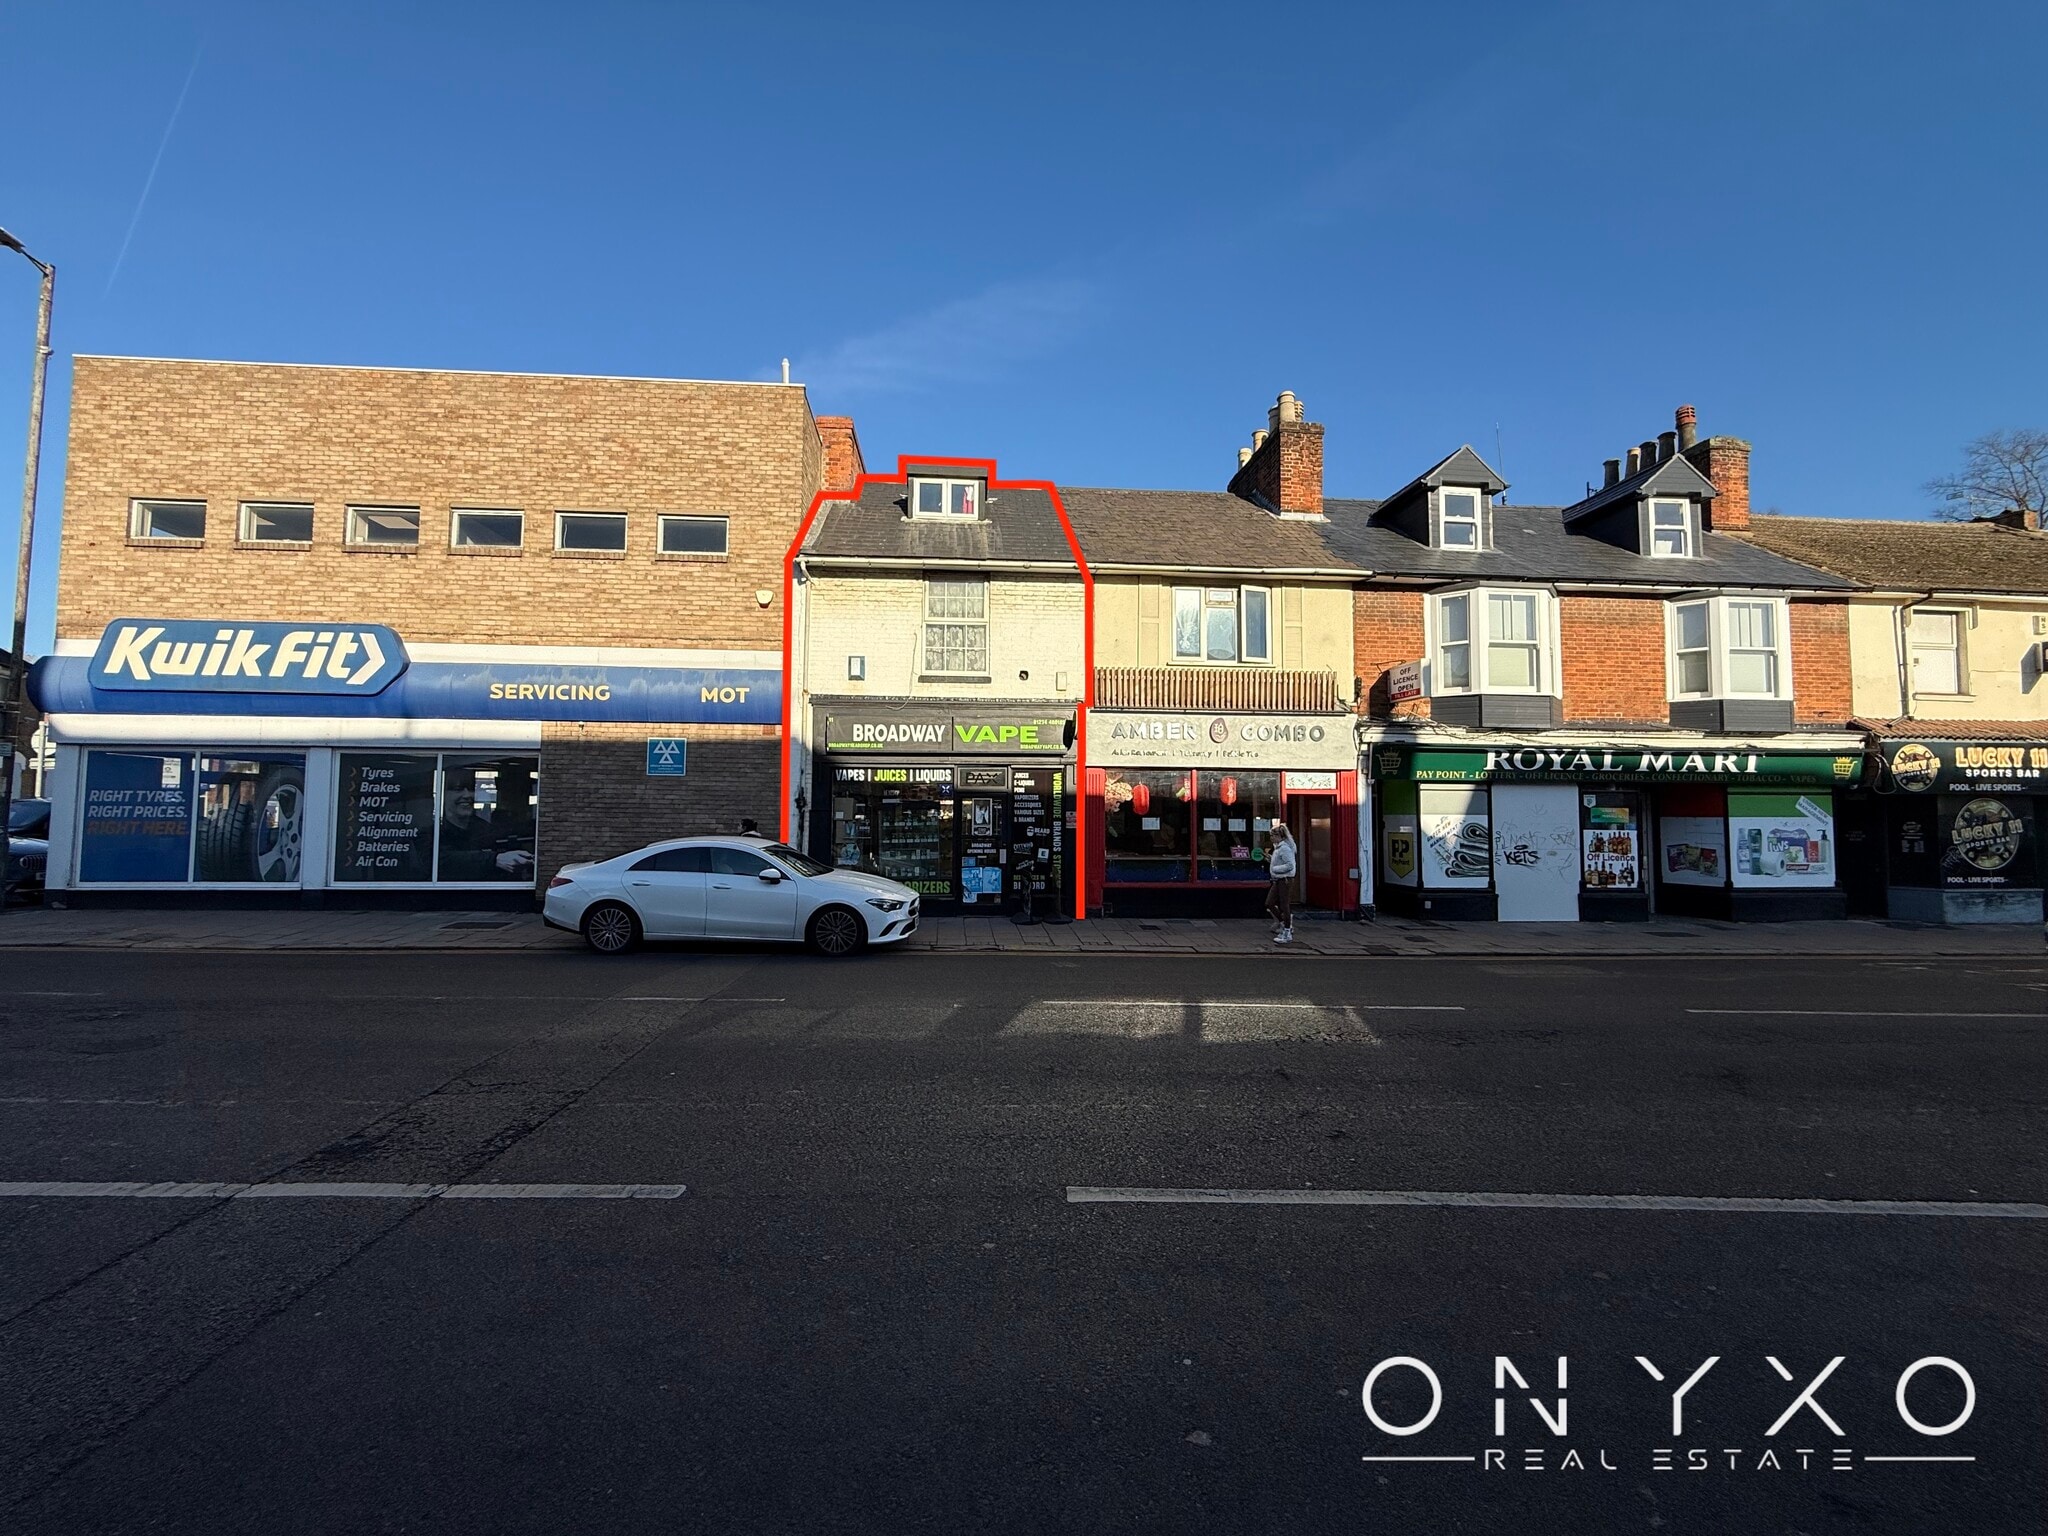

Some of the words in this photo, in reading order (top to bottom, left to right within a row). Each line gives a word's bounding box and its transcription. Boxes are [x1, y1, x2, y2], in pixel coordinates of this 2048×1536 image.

[103, 626, 272, 681] Kwik
[268, 630, 359, 679] Fit
[1400, 667, 1411, 675] OFF
[1393, 674, 1418, 685] LICENCE
[489, 683, 611, 701] SERVICING
[701, 687, 750, 704] MOT
[1398, 683, 1414, 692] OPEN
[853, 723, 945, 742] BROADWAY
[955, 725, 1039, 743] VAPE
[1111, 721, 1197, 740] AMBER
[1240, 724, 1325, 742] COMBO
[1483, 748, 1623, 771] ROYAL
[1635, 751, 1766, 773] MART
[1955, 747, 2025, 768] LUCKY
[2030, 748, 2048, 769] 11
[361, 767, 394, 780] Tyres
[835, 769, 865, 781] VAPES
[873, 769, 907, 782] JUICES
[915, 769, 952, 783] LIQUIDS
[1416, 770, 1434, 779] PAY
[1436, 771, 1466, 779] POINT
[1475, 771, 1517, 779] LOTTERY
[1592, 773, 1645, 781] GROCERIES
[1737, 774, 1782, 782] TOBACCO
[1965, 769, 2012, 777] SPORTS
[2016, 769, 2040, 778] BAR
[360, 782, 401, 793] Brakes
[89, 790, 133, 802] RIGHT
[136, 790, 186, 803] TYRES.
[1053, 772, 1063, 818] WORLDWIDE
[359, 797, 389, 807] MOT
[88, 806, 132, 818] RIGHT
[133, 806, 188, 818] PRICES.
[359, 811, 413, 825] Servicing
[88, 821, 139, 835] RIGHT
[357, 826, 418, 839] Alignment
[1951, 822, 2003, 844] LUCKY
[1053, 821, 1062, 851] BRANDS
[357, 840, 410, 852] Batteries
[355, 855, 374, 867] Air
[376, 855, 398, 867] Con
[1587, 853, 1600, 861] Off
[1602, 853, 1636, 862] Licence
